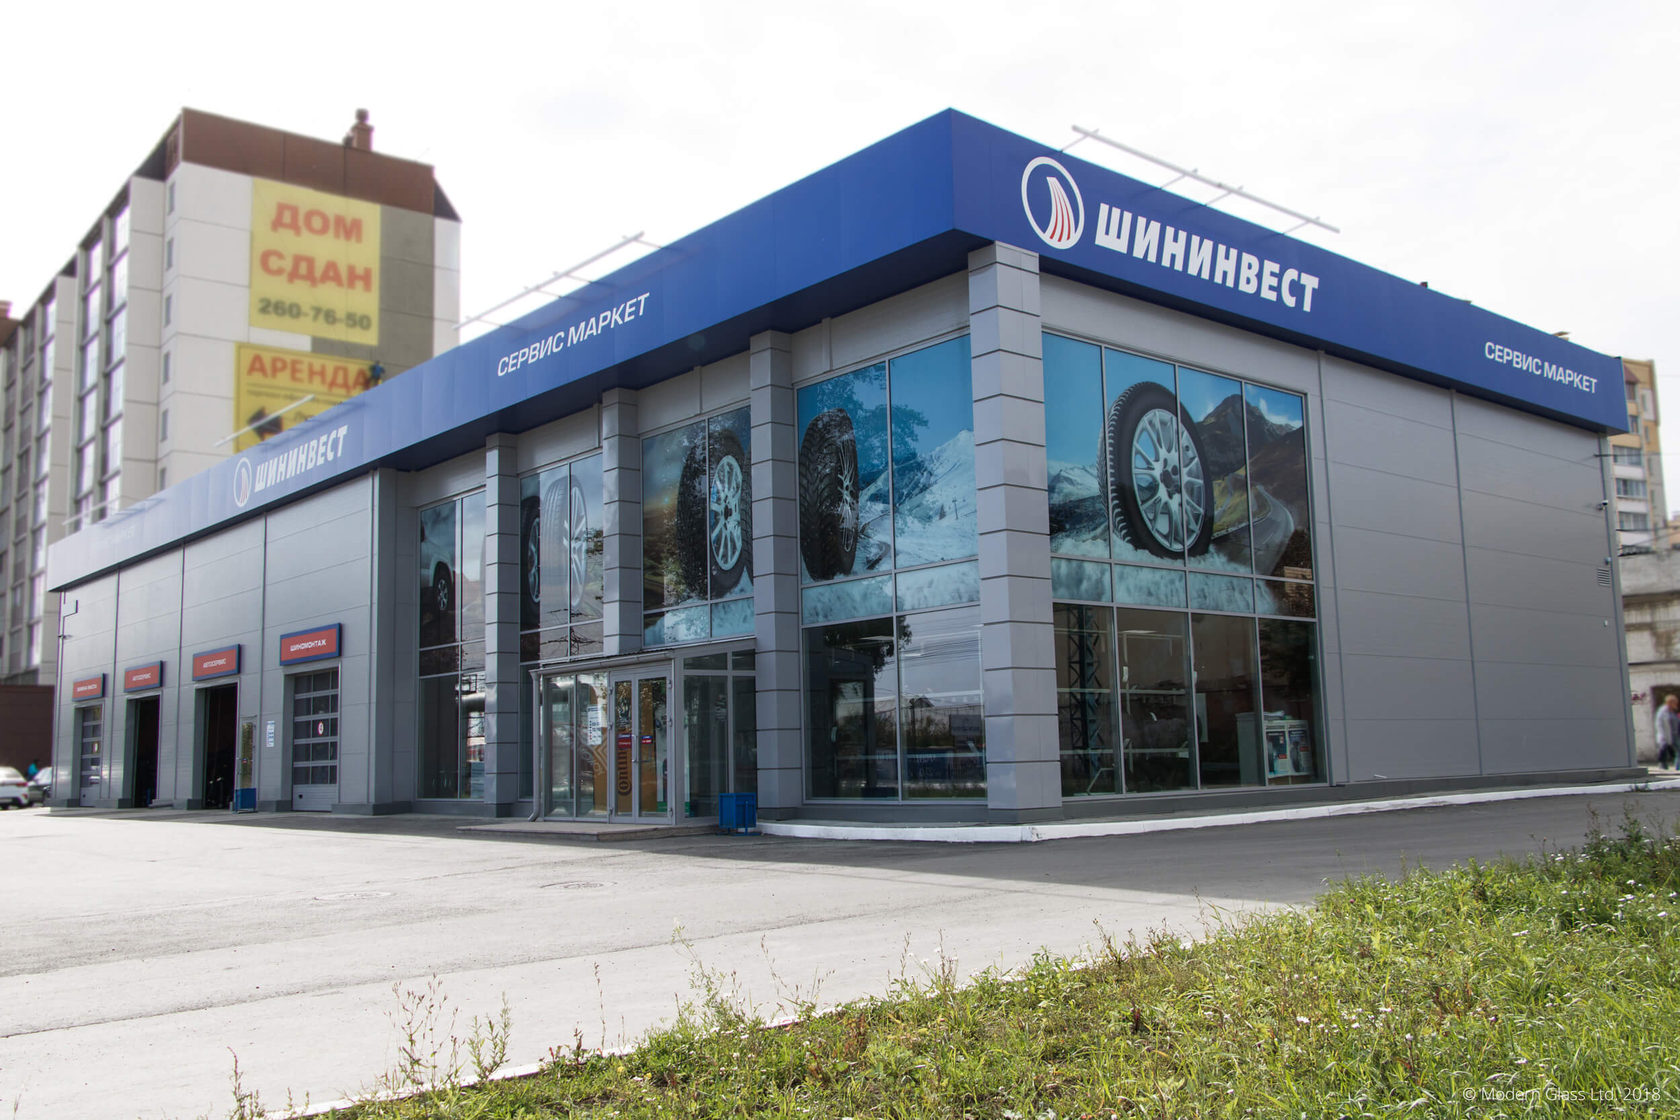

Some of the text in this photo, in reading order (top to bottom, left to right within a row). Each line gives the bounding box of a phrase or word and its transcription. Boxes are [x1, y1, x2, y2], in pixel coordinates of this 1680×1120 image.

[270, 202, 363, 244] ДОМ
[259, 248, 372, 293] СДАН
[1095, 202, 1319, 312] ШИНИНВЕСТ
[258, 297, 372, 331] 260-76-50
[497, 292, 650, 377] СЕРВИС МАРКЕТ
[247, 353, 371, 395] АРЕНДА
[1485, 341, 1598, 393] СЕРВИС МАРКЕТ
[254, 425, 348, 493] ШИНИНВЕСТ
